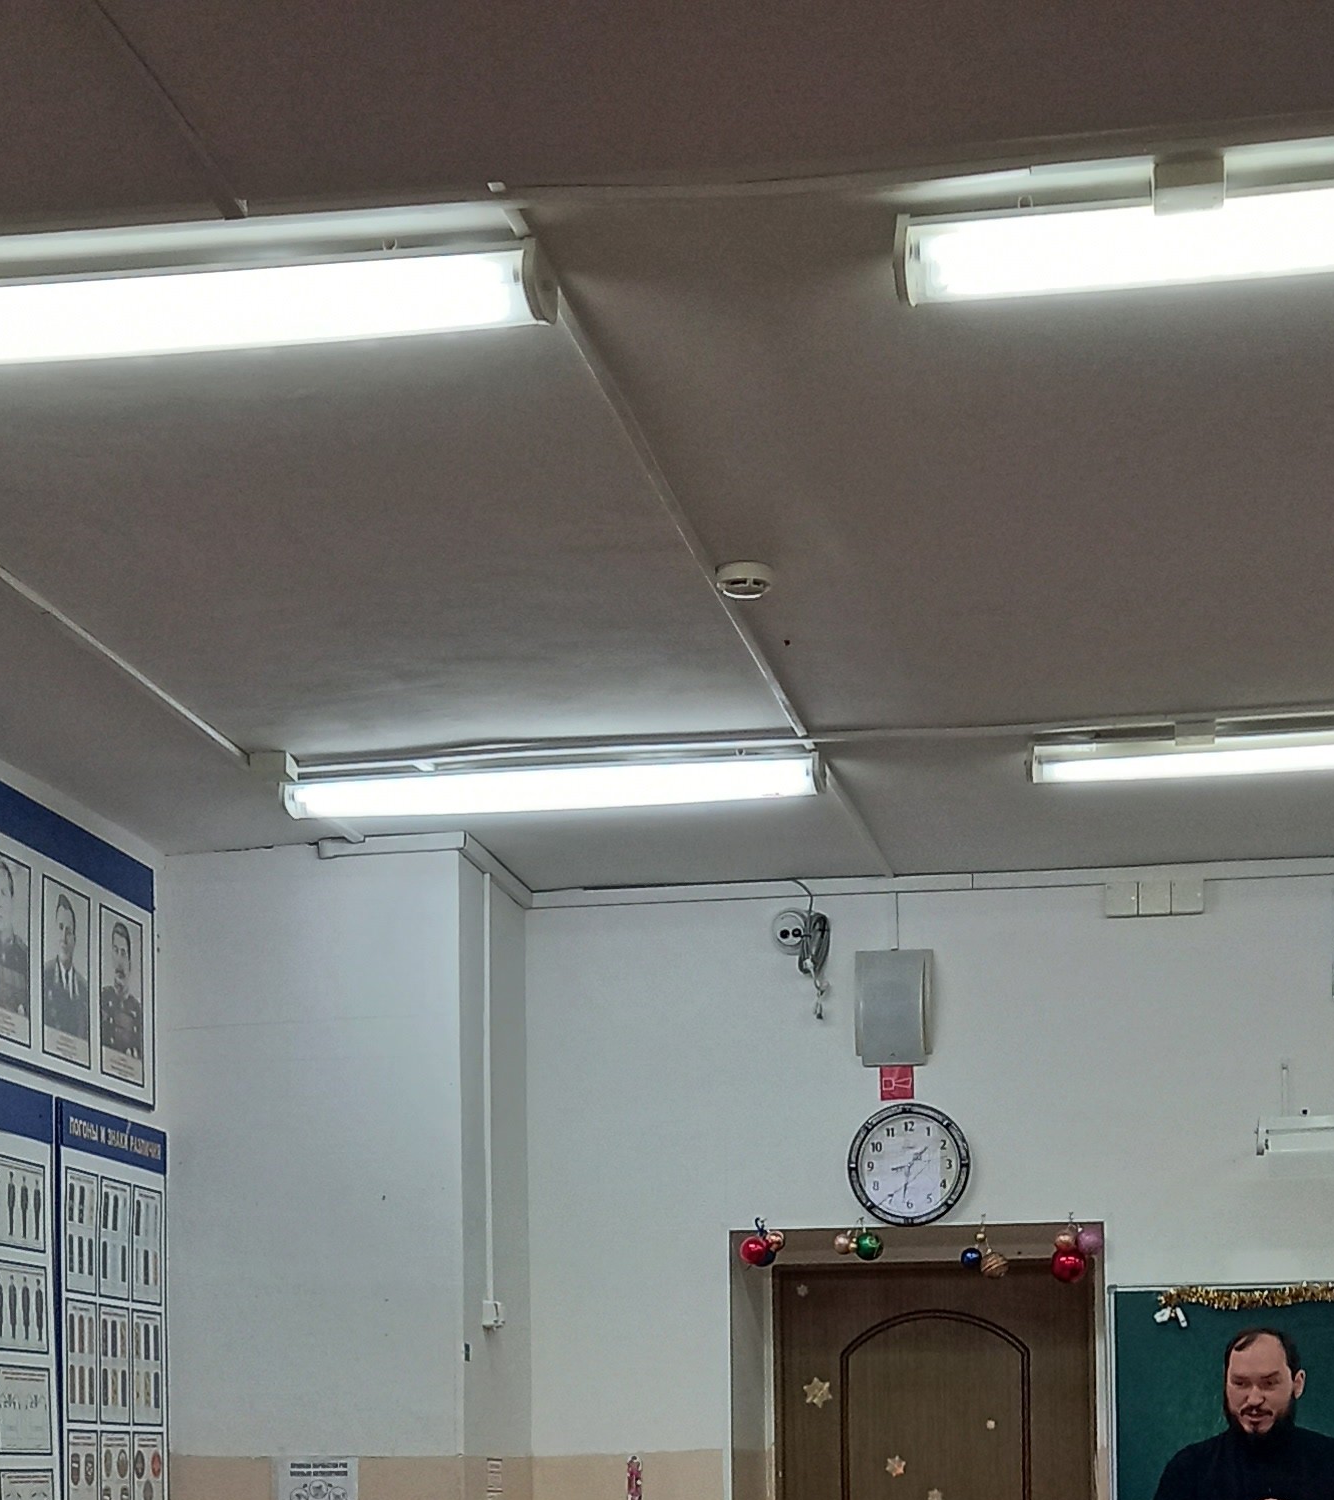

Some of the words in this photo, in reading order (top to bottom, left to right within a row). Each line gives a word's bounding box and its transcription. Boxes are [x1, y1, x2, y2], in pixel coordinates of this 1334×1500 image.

[903, 1121, 915, 1132] 12
[926, 1127, 931, 1136] 1
[886, 1128, 895, 1137] 11
[871, 1141, 882, 1152] 10
[940, 1140, 947, 1150] 2
[867, 1161, 874, 1171] 9
[946, 1159, 952, 1169] 3
[872, 1181, 879, 1191] 8
[939, 1179, 946, 1189] 4
[888, 1193, 894, 1204] 7
[927, 1193, 932, 1203] 5
[906, 1200, 913, 1209] 6
